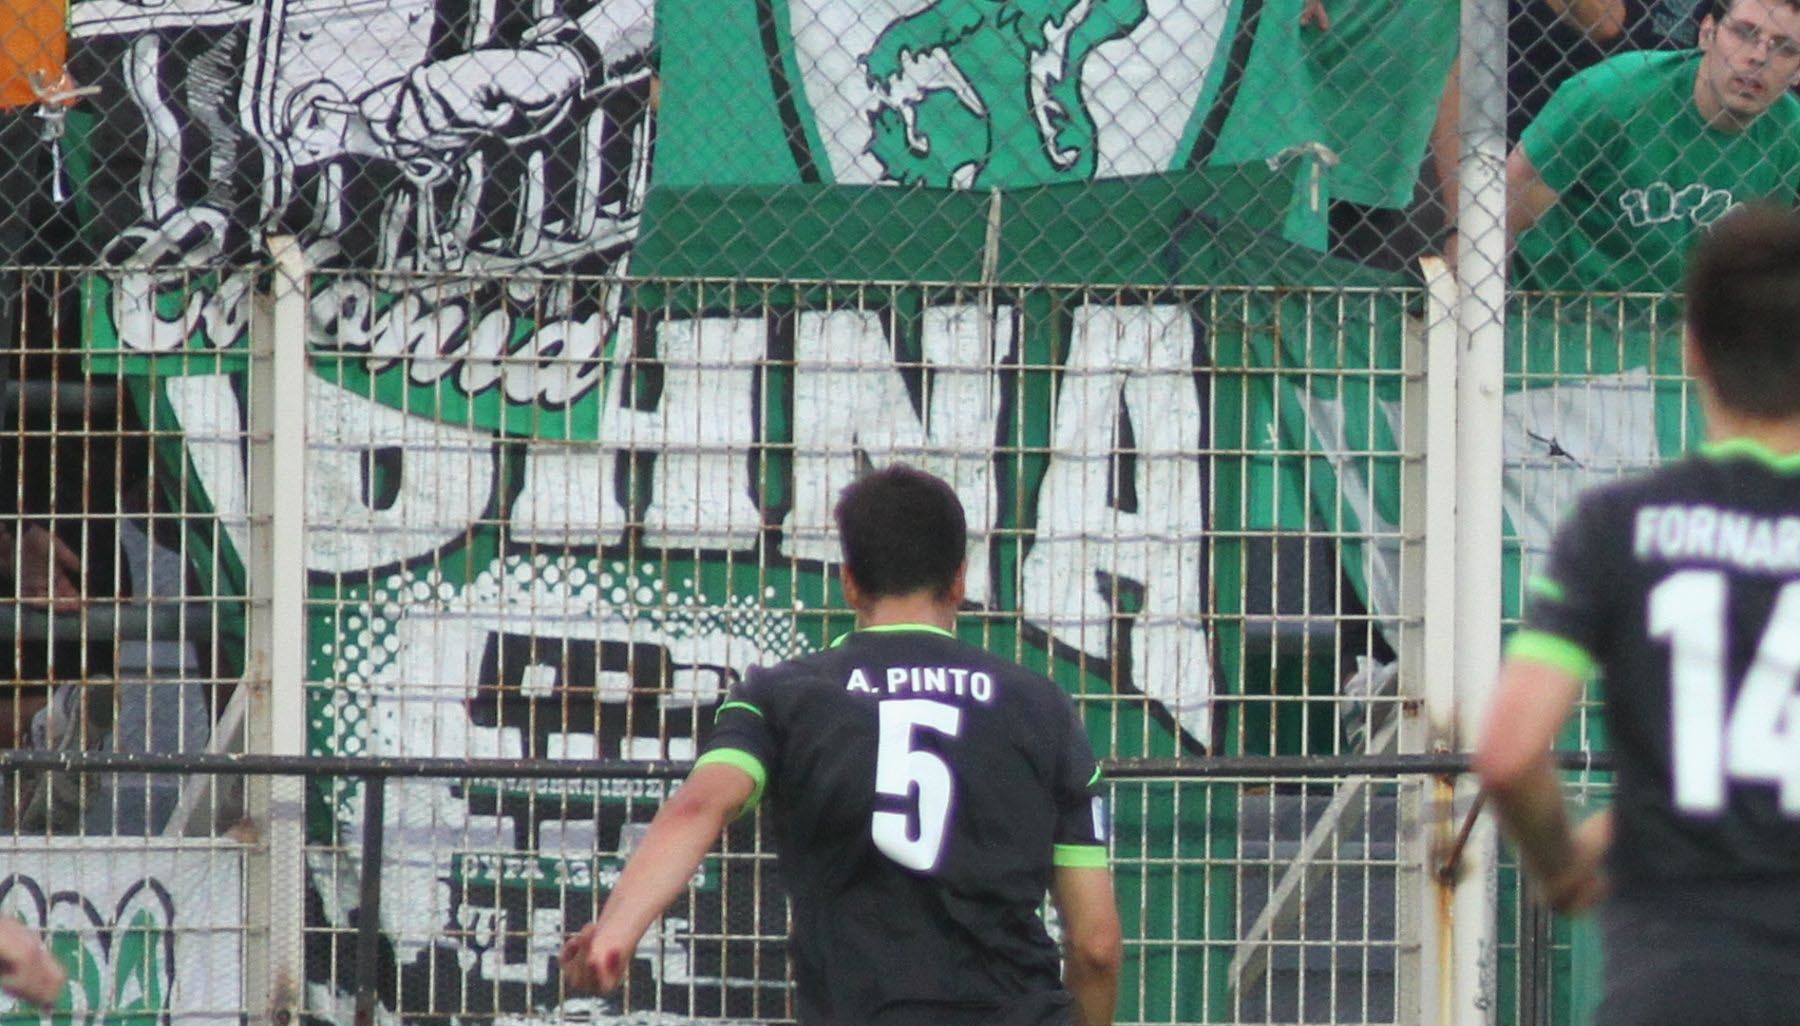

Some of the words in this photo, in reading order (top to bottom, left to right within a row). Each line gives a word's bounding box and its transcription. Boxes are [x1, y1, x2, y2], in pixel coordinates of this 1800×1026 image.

[846, 667, 880, 694] A.
[886, 667, 992, 701] PINTO
[871, 698, 960, 871] 5
